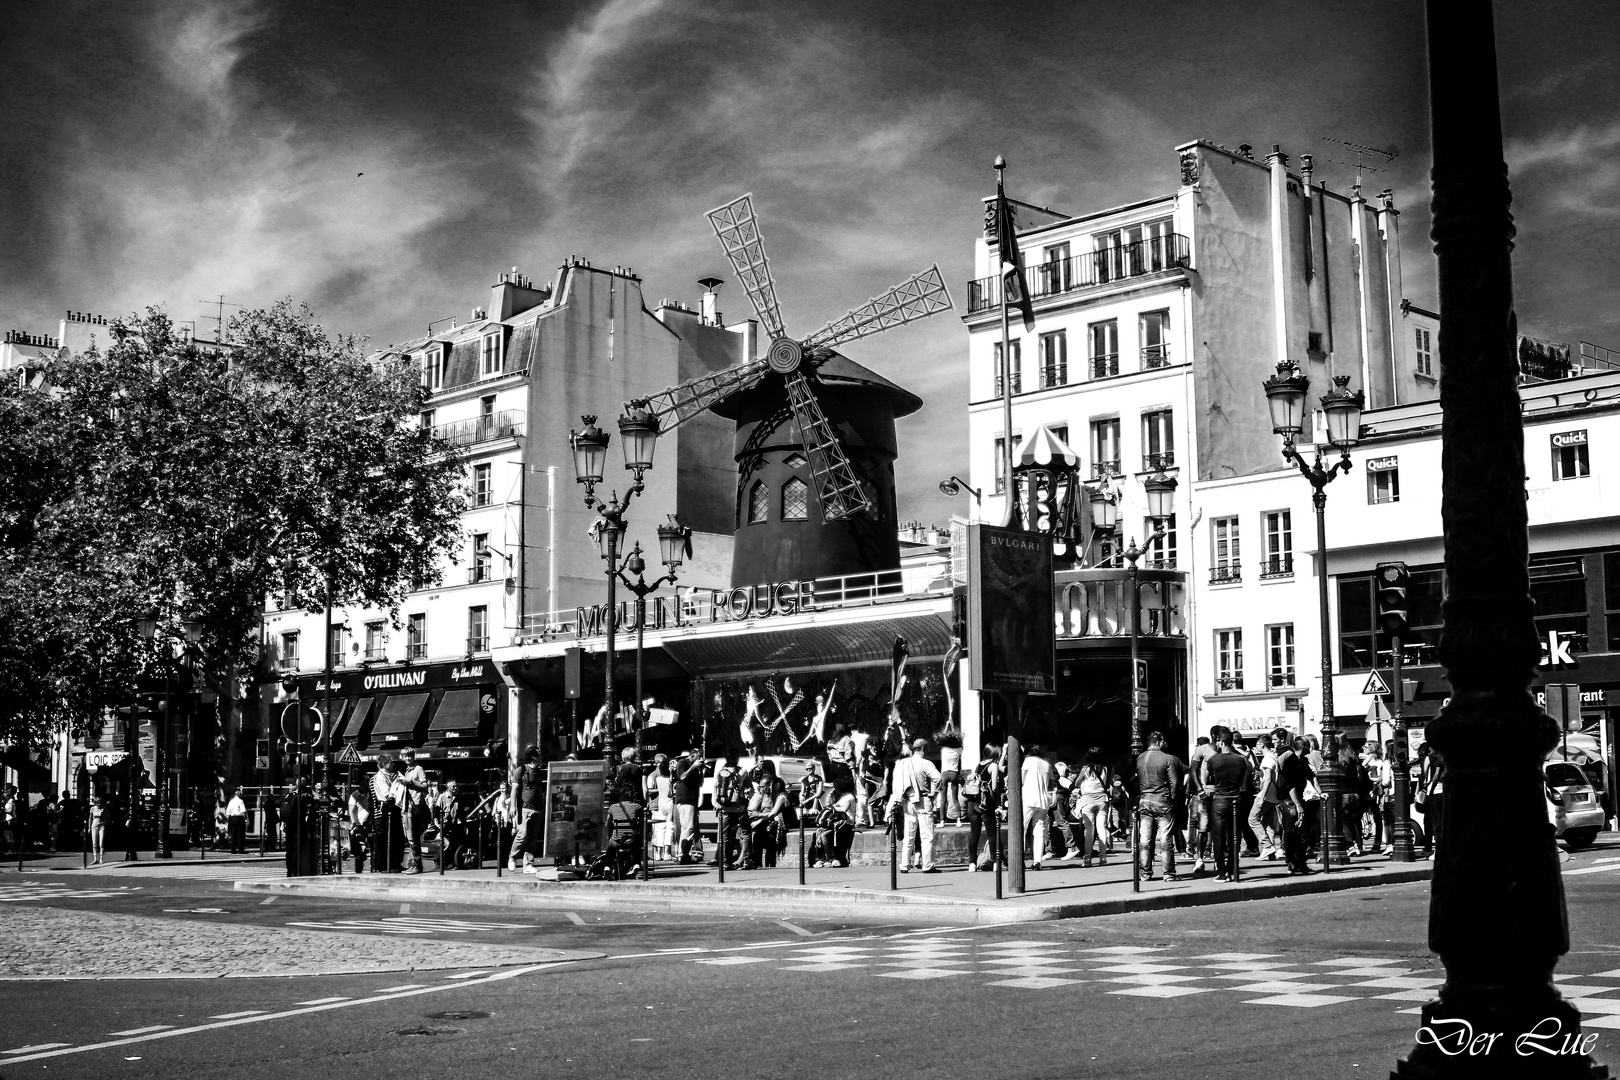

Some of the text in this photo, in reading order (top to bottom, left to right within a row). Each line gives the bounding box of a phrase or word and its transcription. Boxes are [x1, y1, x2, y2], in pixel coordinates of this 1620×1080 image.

[1551, 431, 1587, 446] Quick
[1367, 457, 1399, 471] Quick
[990, 536, 1040, 551] BVLGARI
[709, 578, 816, 623] ROUGE
[1055, 580, 1187, 638] OUGE
[451, 665, 484, 682] By the Mill
[1136, 666, 1145, 684] P
[1216, 715, 1287, 731] CHANGE
[88, 754, 109, 767] LOIC
